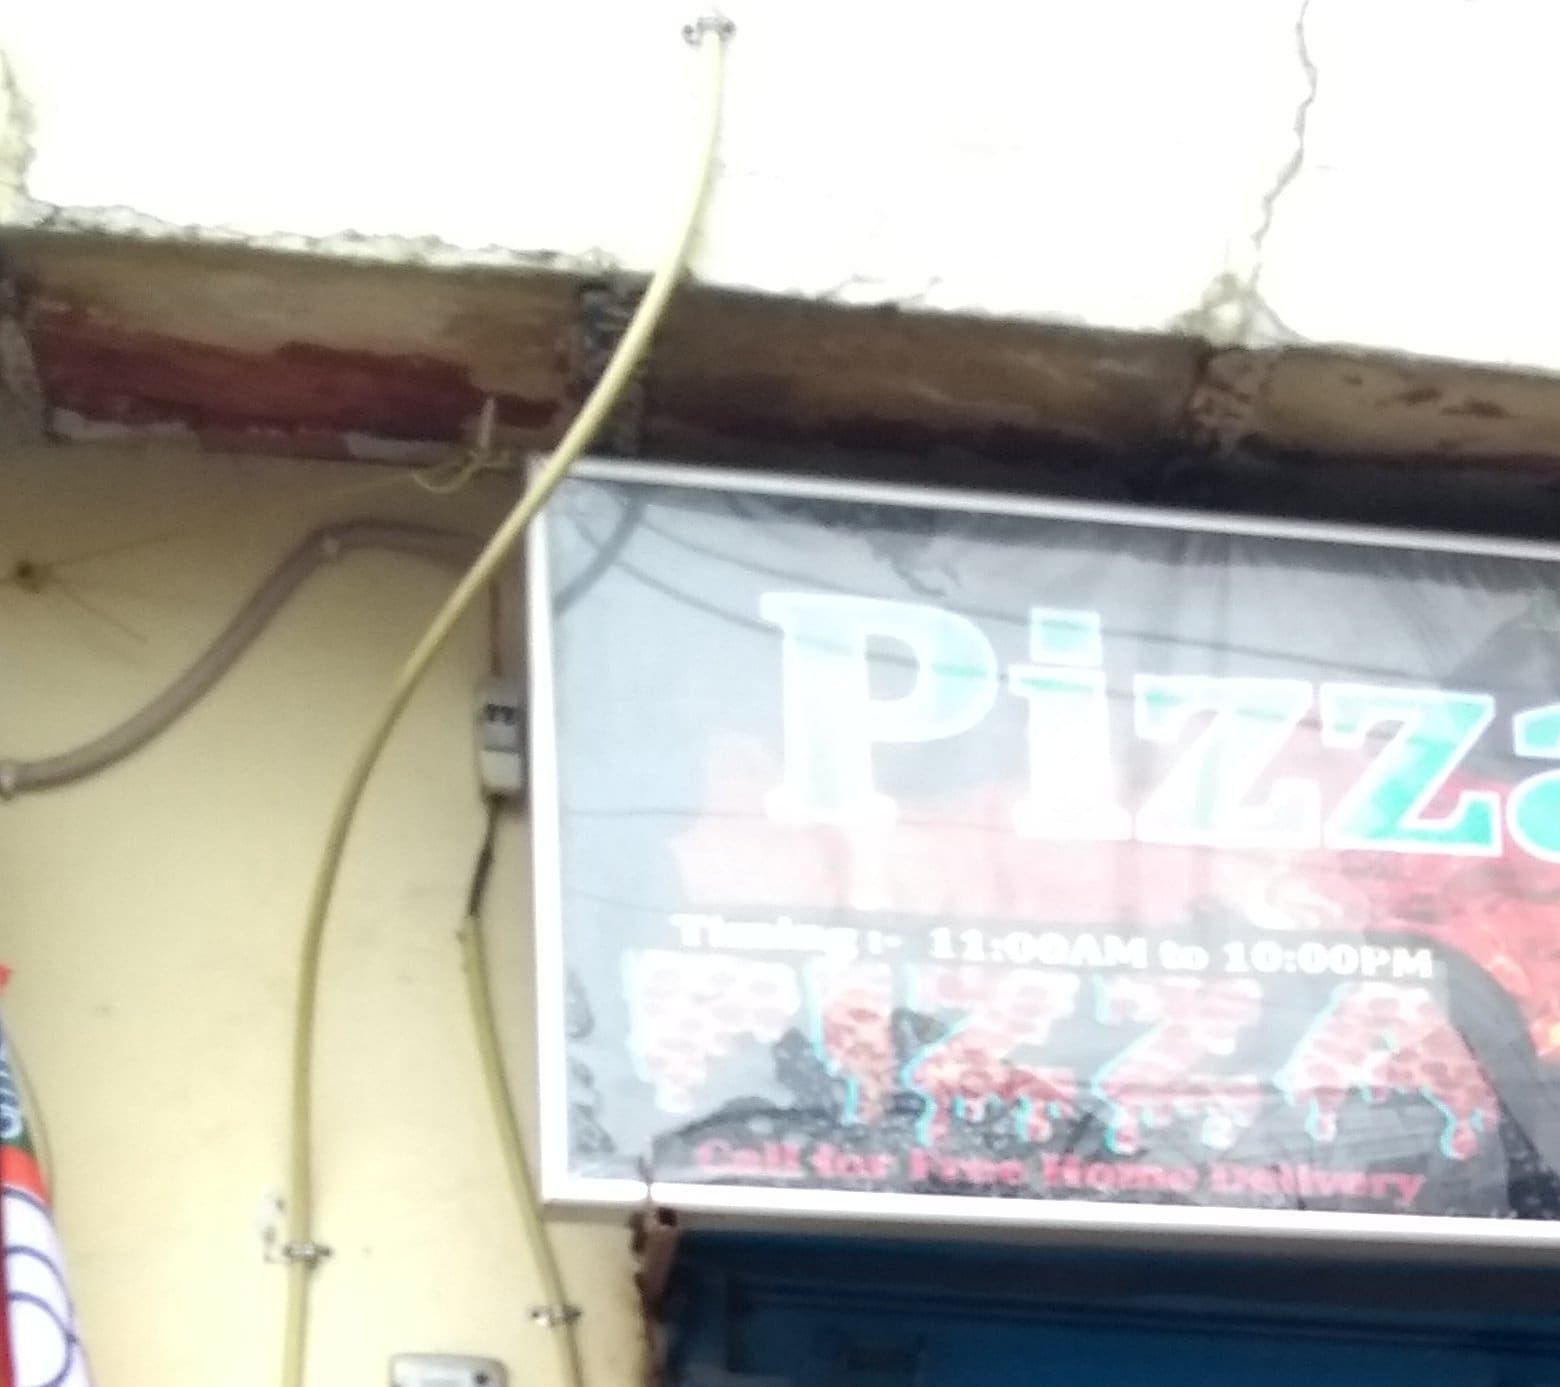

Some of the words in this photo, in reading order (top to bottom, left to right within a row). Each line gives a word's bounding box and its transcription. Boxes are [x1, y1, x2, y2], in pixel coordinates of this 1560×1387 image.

[671, 911, 858, 964] Timing
[929, 926, 1148, 970] 11:00AM
[1158, 936, 1209, 971] to
[1223, 938, 1435, 979] 10:00PM
